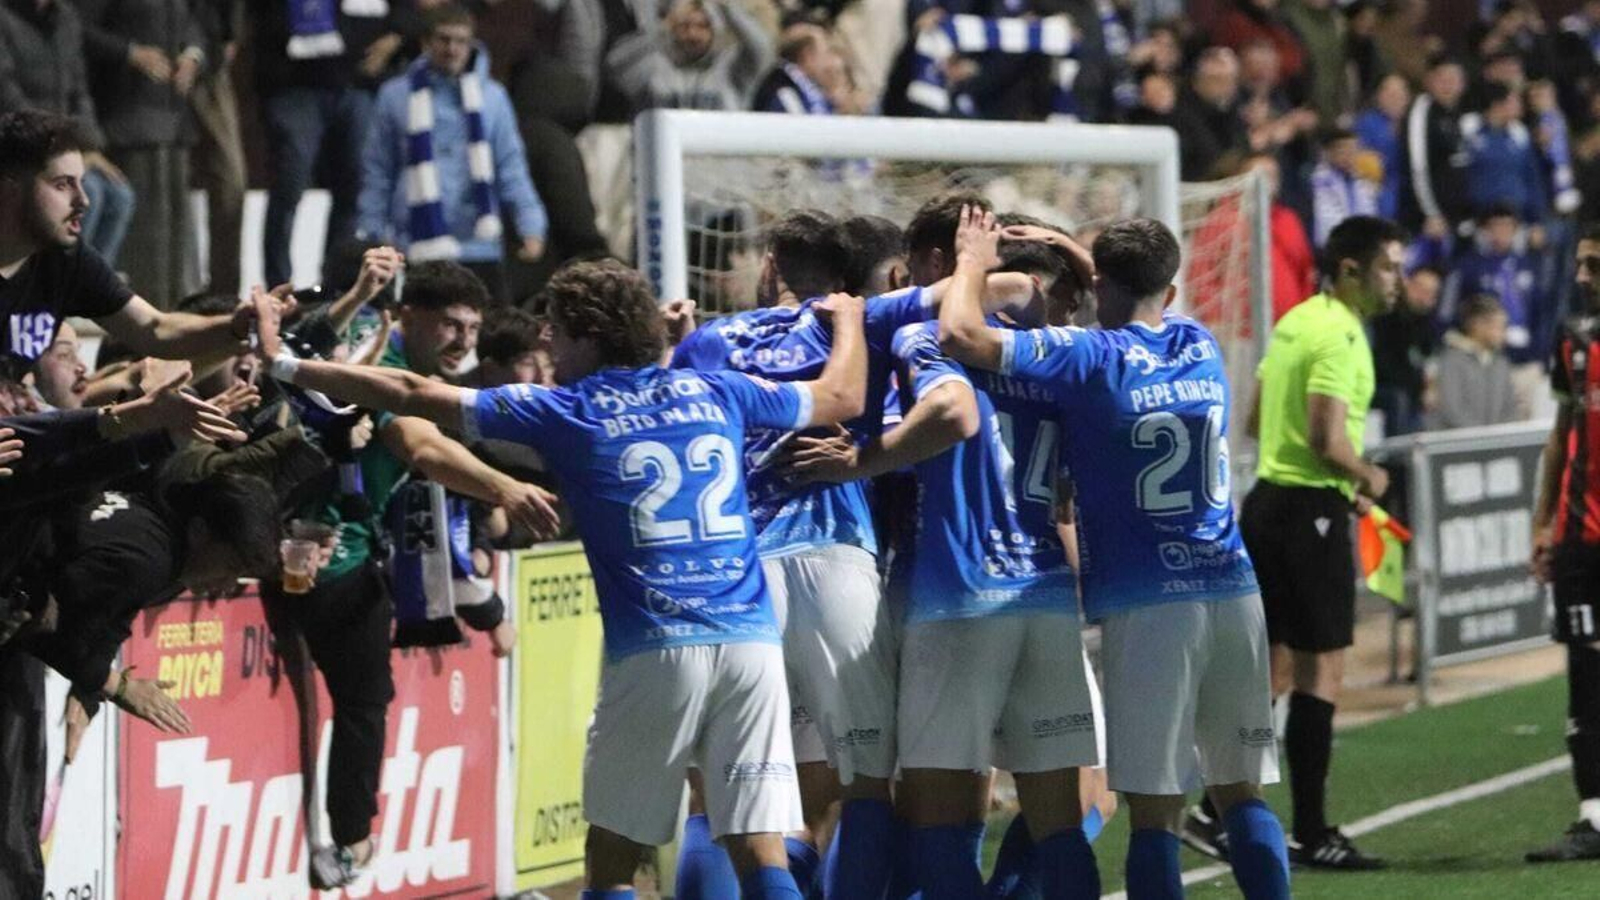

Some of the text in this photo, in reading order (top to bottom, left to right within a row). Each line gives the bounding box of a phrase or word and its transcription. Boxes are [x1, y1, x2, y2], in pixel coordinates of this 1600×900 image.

[601, 401, 728, 439] BETO PLAZA
[1130, 387, 1175, 414] PEPE
[618, 433, 747, 548] 22
[1131, 404, 1231, 517] 26
